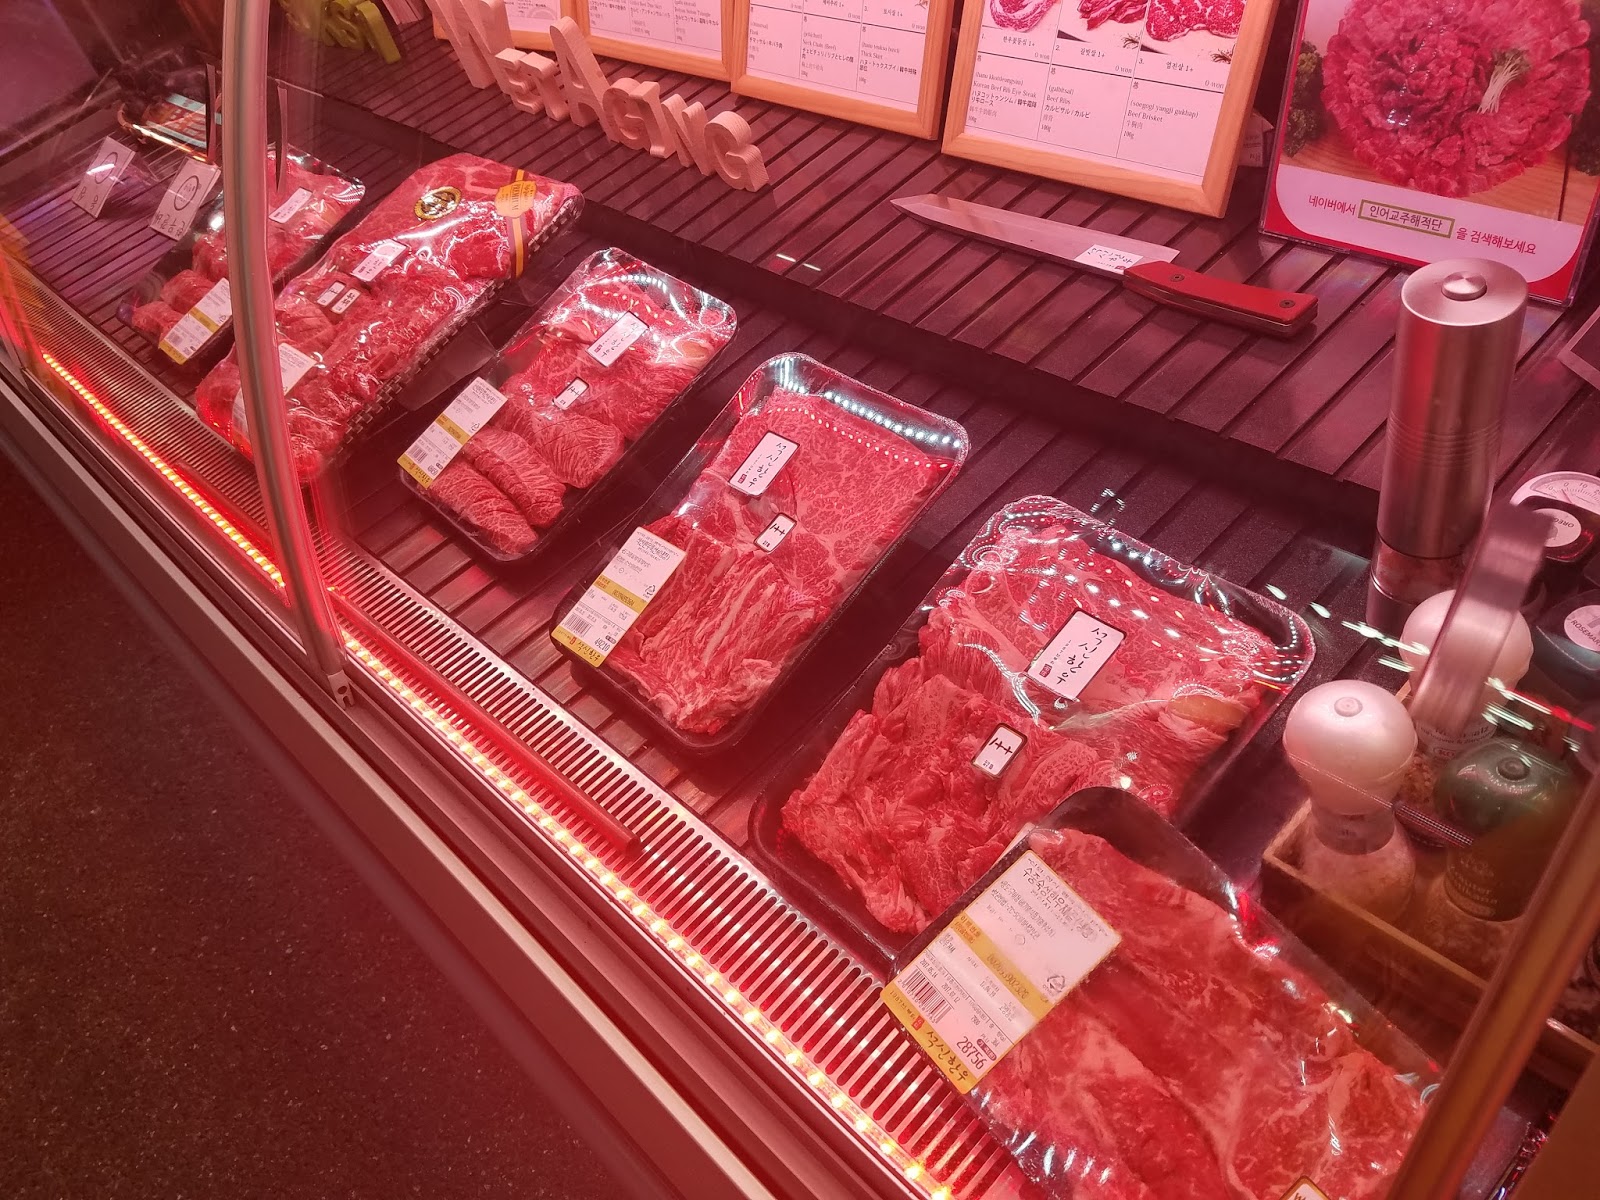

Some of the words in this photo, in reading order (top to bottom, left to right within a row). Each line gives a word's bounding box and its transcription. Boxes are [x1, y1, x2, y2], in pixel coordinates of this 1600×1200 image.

[1166, 61, 1184, 72] 업진살
[973, 80, 990, 90] Korean
[990, 83, 1003, 92] Beef
[1002, 86, 1011, 94] Rib
[1011, 88, 1022, 97] Eye
[1022, 90, 1037, 99] Steak
[1046, 94, 1059, 103] Beef
[1059, 97, 1071, 105] Ribs
[1127, 109, 1141, 118] Beef
[1141, 112, 1163, 123] Brisket
[1308, 194, 1357, 216] 네이버에서
[1369, 204, 1443, 232] 인어교주해적단
[1456, 227, 1468, 241] 을
[1470, 230, 1537, 256] 검색해보세요
[593, 636, 612, 653] 49210
[1056, 627, 1108, 685] 석신한우
[925, 1030, 970, 1082] 석신한우
[955, 1036, 988, 1070] 28756
